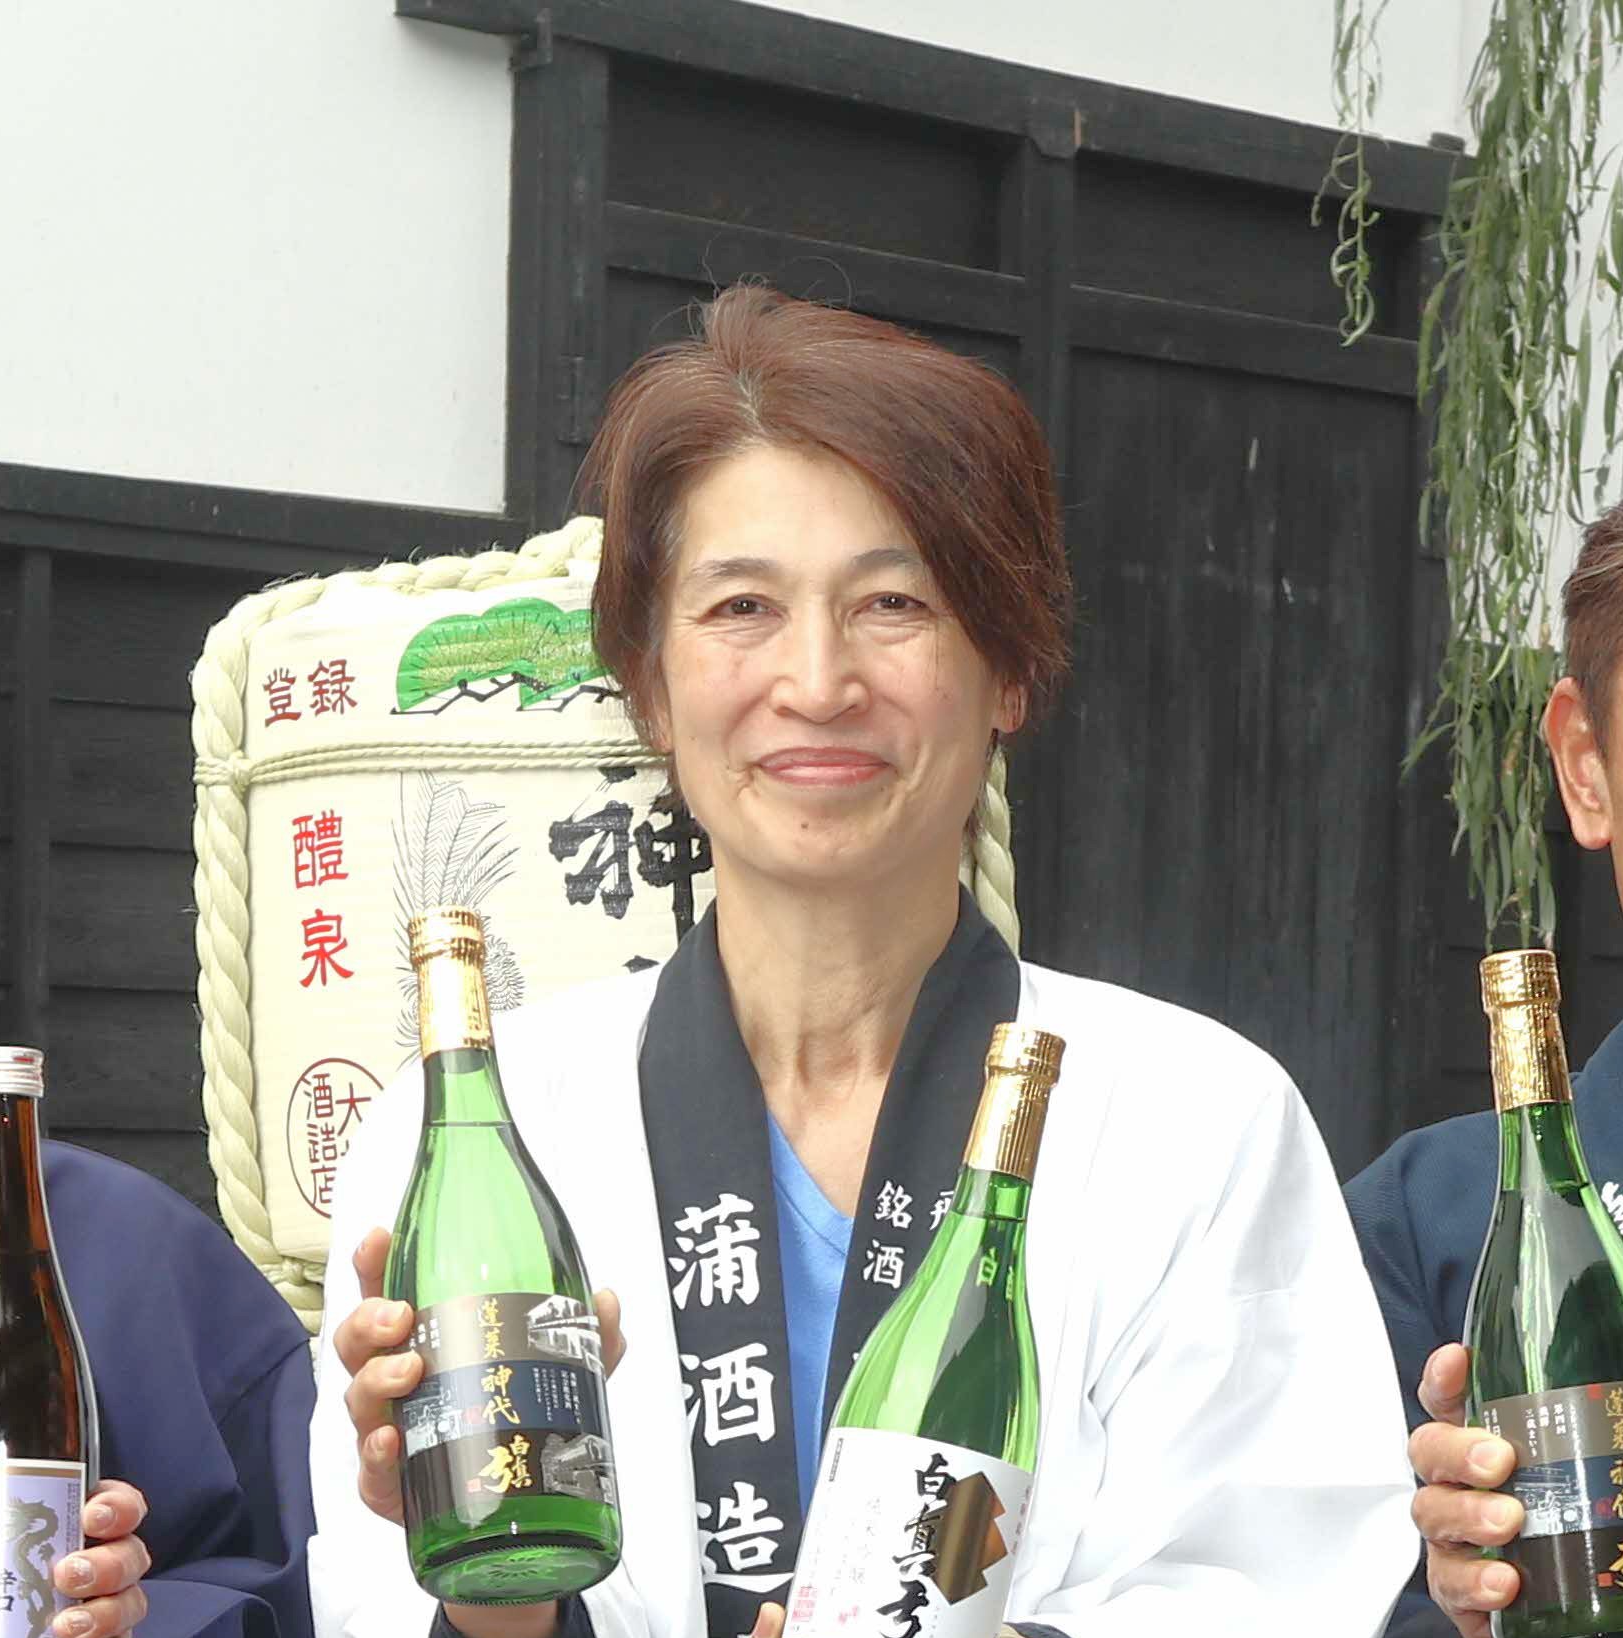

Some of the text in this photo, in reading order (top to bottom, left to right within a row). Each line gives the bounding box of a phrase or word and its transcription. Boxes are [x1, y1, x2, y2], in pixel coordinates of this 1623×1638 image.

[263, 659, 357, 727] 登録
[549, 766, 714, 973] 神
[863, 1180, 914, 1289] 銘酒
[480, 1364, 521, 1425] 神代
